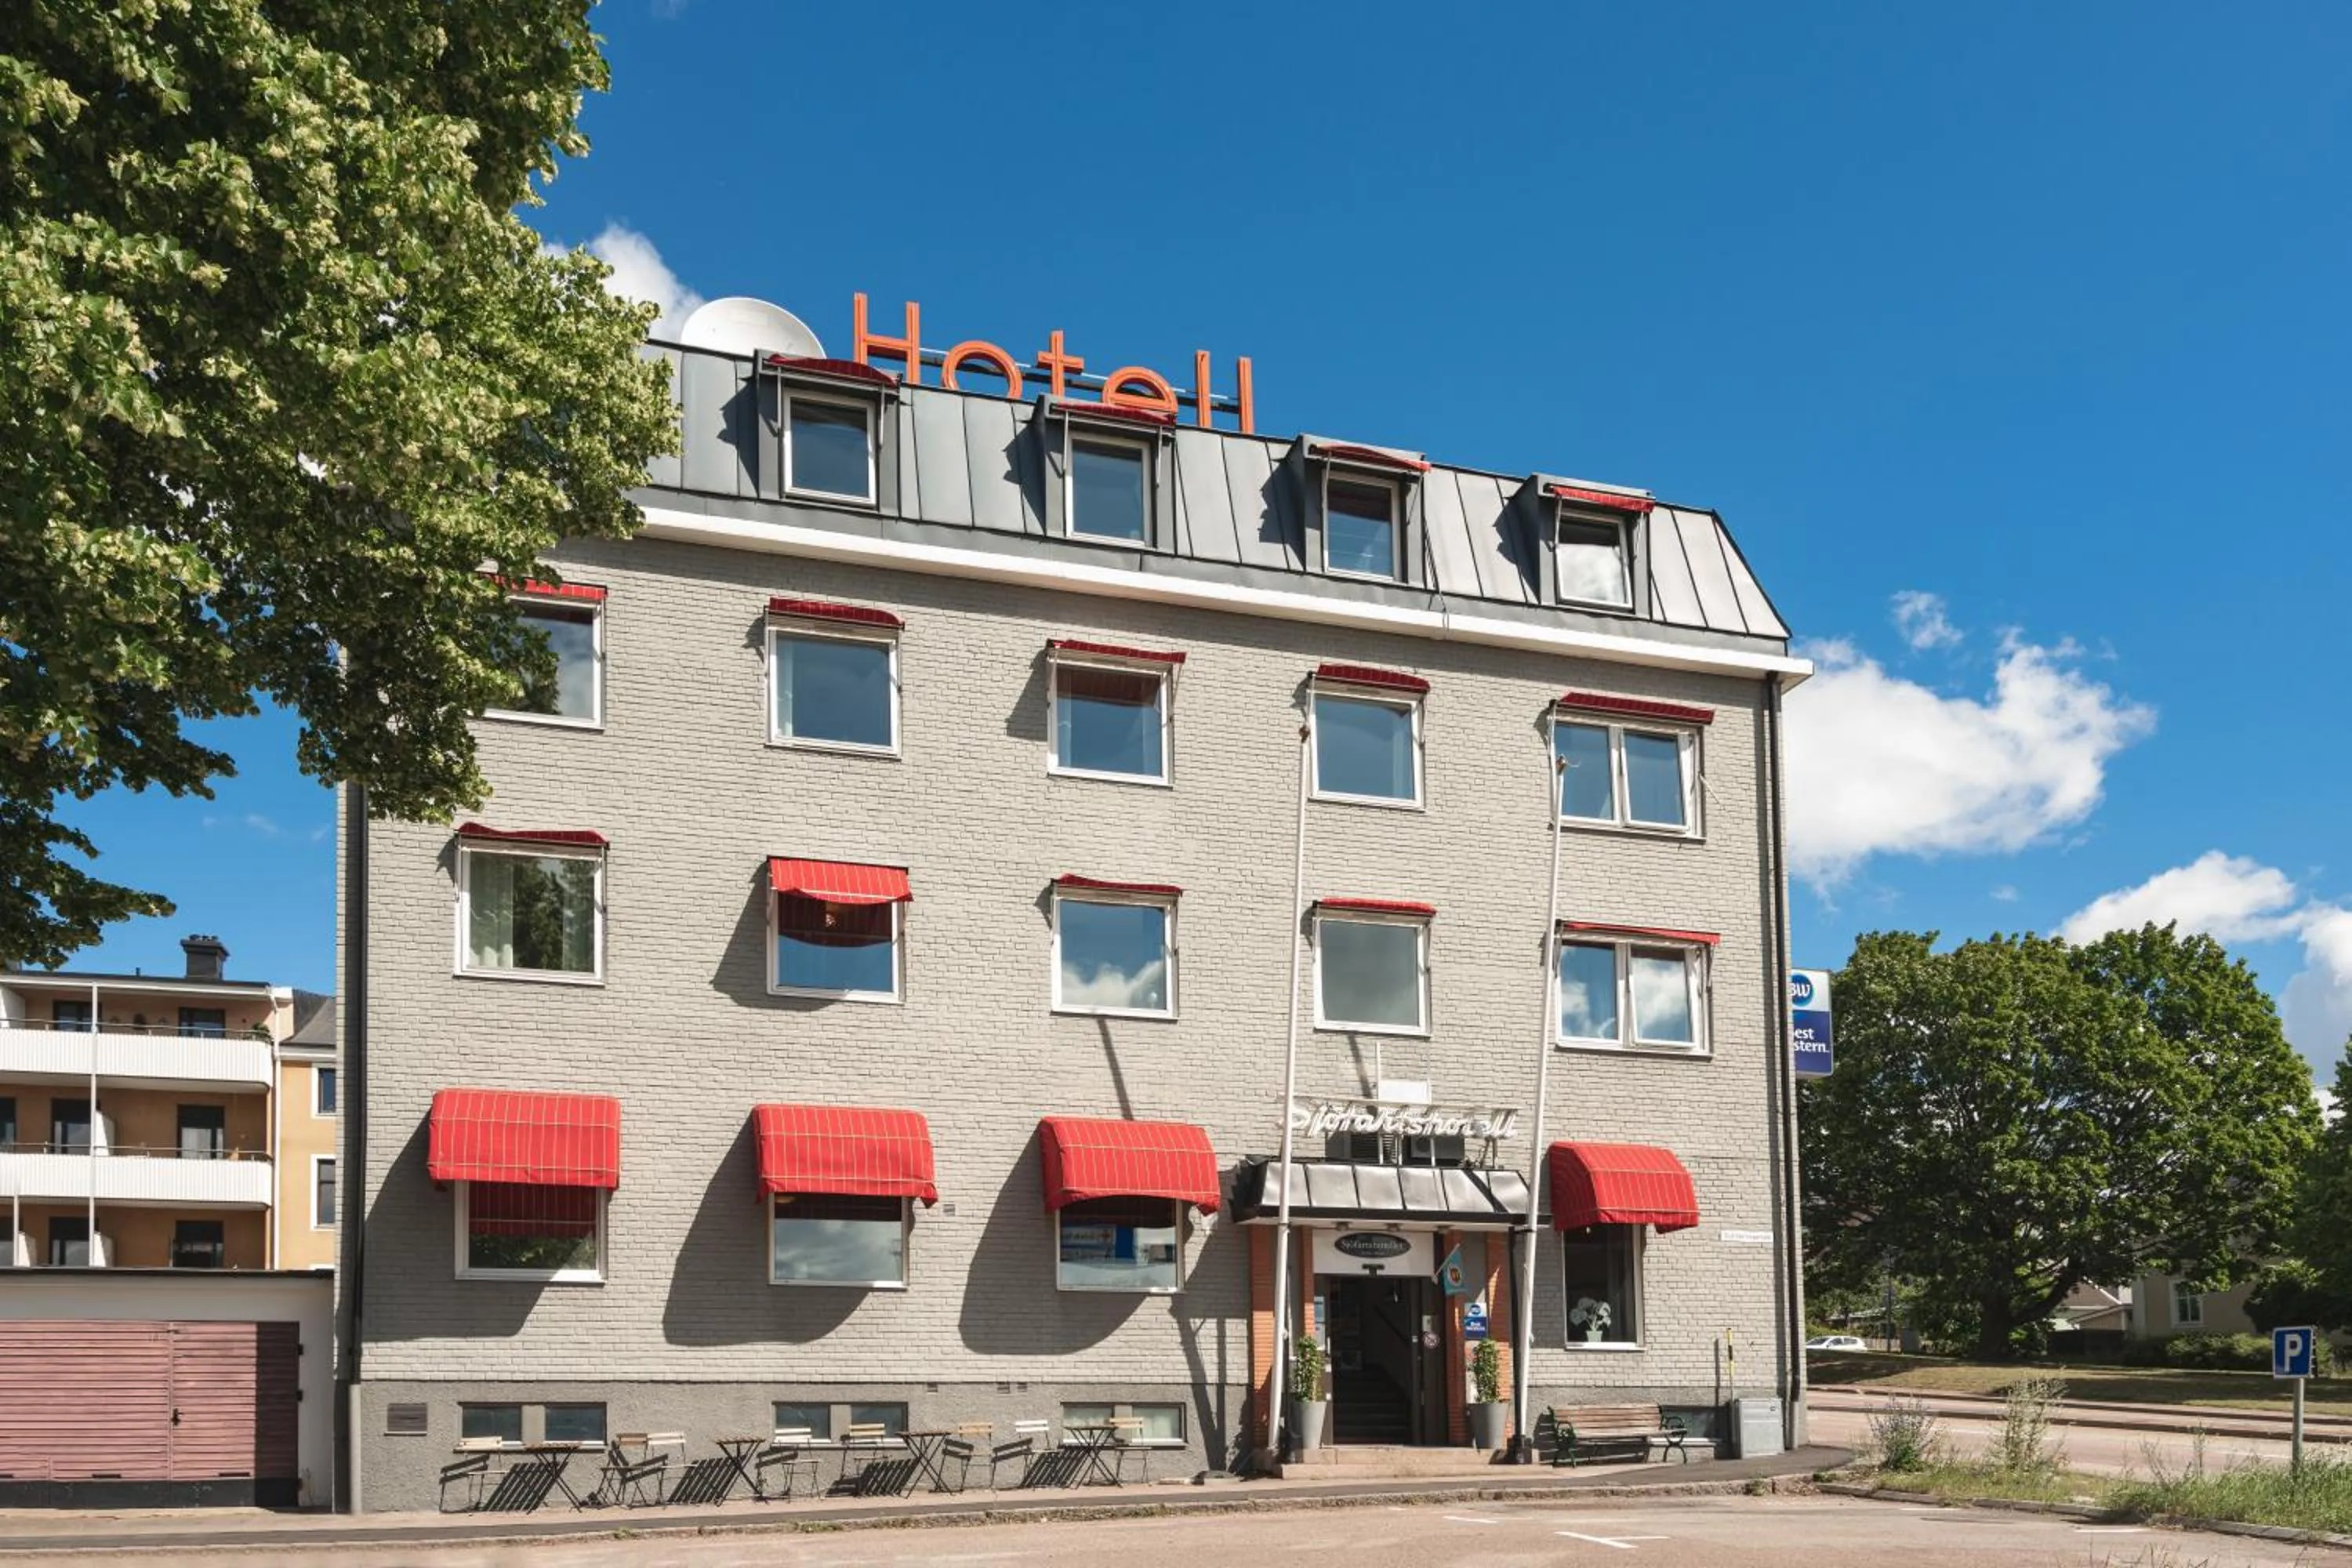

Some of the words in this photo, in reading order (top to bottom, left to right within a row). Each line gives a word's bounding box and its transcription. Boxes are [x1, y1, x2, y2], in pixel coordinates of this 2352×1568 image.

[854, 292, 1254, 434] Hotell
[1795, 1028, 1814, 1040] est
[2284, 1334, 2303, 1373] P
